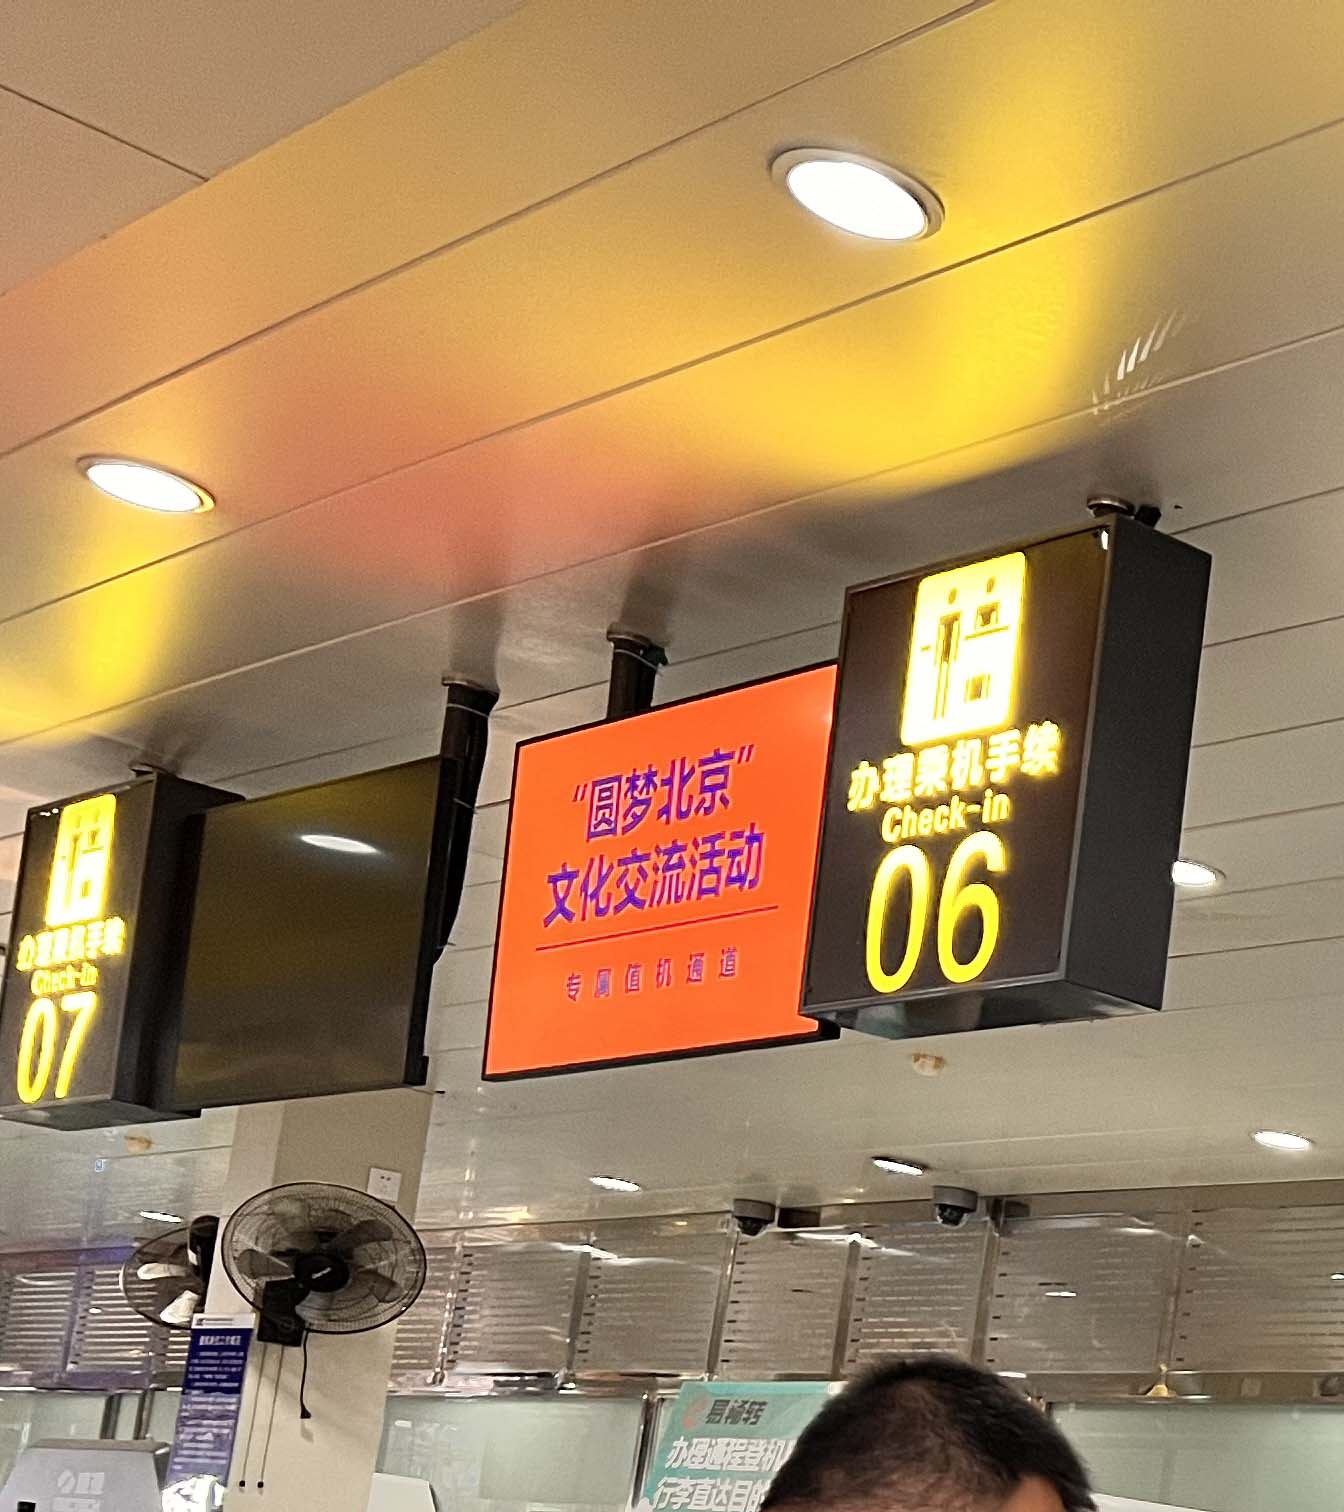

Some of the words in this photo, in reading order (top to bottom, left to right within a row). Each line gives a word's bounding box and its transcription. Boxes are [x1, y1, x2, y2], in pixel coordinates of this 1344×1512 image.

[847, 720, 1062, 812] 办理乘机手续
[882, 788, 1012, 844] Check-in
[543, 822, 766, 928] 文化交流活动
[866, 830, 1008, 994] 06
[566, 947, 739, 1002] 专属值机通道
[16, 990, 97, 1104] 07
[664, 1436, 797, 1472] 办理通程登机
